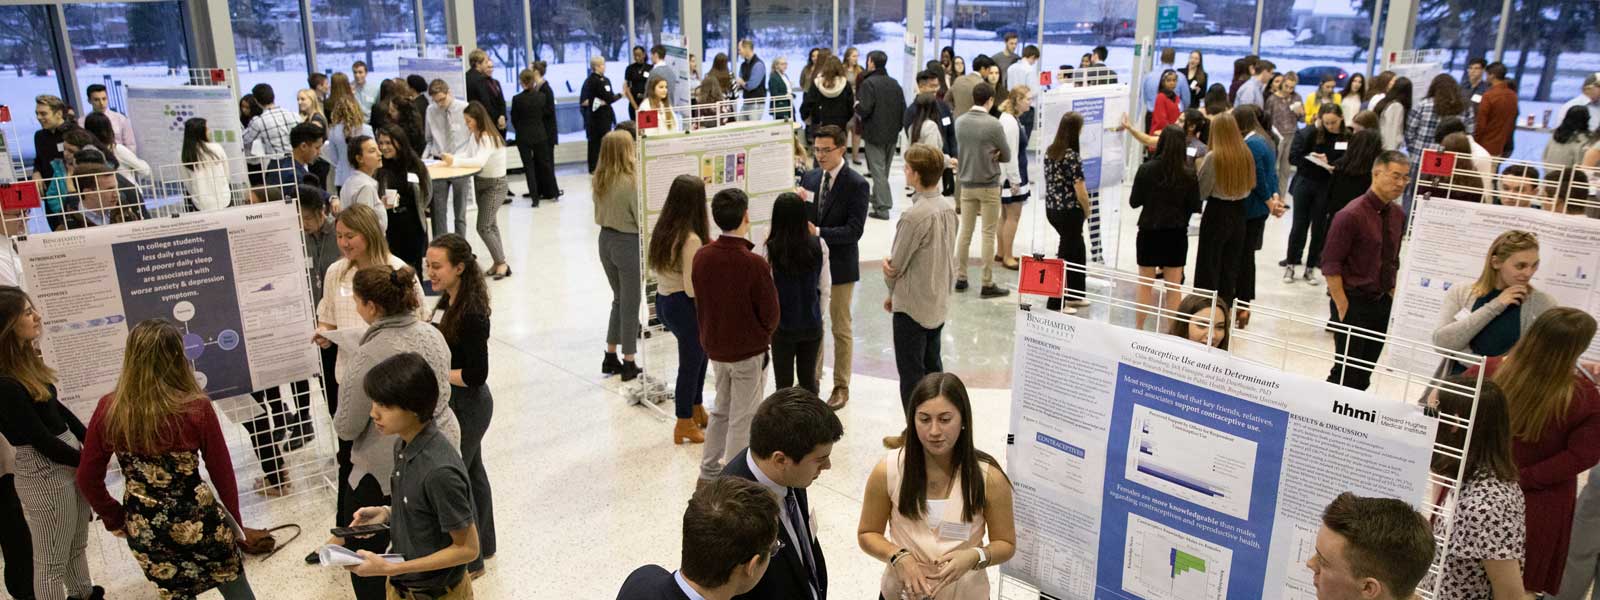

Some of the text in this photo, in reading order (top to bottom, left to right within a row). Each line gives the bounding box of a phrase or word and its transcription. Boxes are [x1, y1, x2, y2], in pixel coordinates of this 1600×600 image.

[1434, 158, 1442, 167] 3
[16, 190, 22, 200] 1
[137, 236, 205, 252] In college students,
[142, 246, 204, 262] less daily exercise
[136, 256, 213, 274] and poorer daily sleep
[156, 269, 192, 280] associated
[194, 266, 210, 274] with
[130, 288, 153, 296] worse
[154, 282, 180, 292] anxiety
[188, 274, 225, 286] depression
[1039, 269, 1046, 284] 1
[161, 290, 200, 302] symptoms.
[1026, 313, 1076, 333] BINGHAMTON
[1026, 322, 1075, 339] UNIVERSITY
[1024, 336, 1061, 351] INTRODUCTION
[1131, 342, 1180, 362] Contraceptive
[1182, 356, 1196, 366] Use
[1196, 361, 1212, 371] and
[1212, 364, 1222, 374] its
[1224, 368, 1280, 390] Determinants
[1124, 374, 1274, 428] Most respondents feel that key friends, relatives,
[1132, 388, 1262, 433] and associates support contraceptive use.
[1332, 400, 1376, 423] hhmi
[1290, 414, 1318, 426] RESULTS
[1326, 423, 1368, 440] DISCUSSION
[1380, 420, 1427, 436] Medical Institute
[1382, 415, 1427, 431] Howard Hughes
[1110, 490, 1138, 507] regarding
[1138, 501, 1182, 521] contraceptives
[1182, 517, 1195, 527] and
[1196, 522, 1238, 541] reproductive
[1116, 483, 1140, 498] Females
[1152, 498, 1168, 507] more
[1168, 502, 1218, 526] knowledgeable
[1220, 520, 1236, 532] than
[1236, 526, 1256, 540] males
